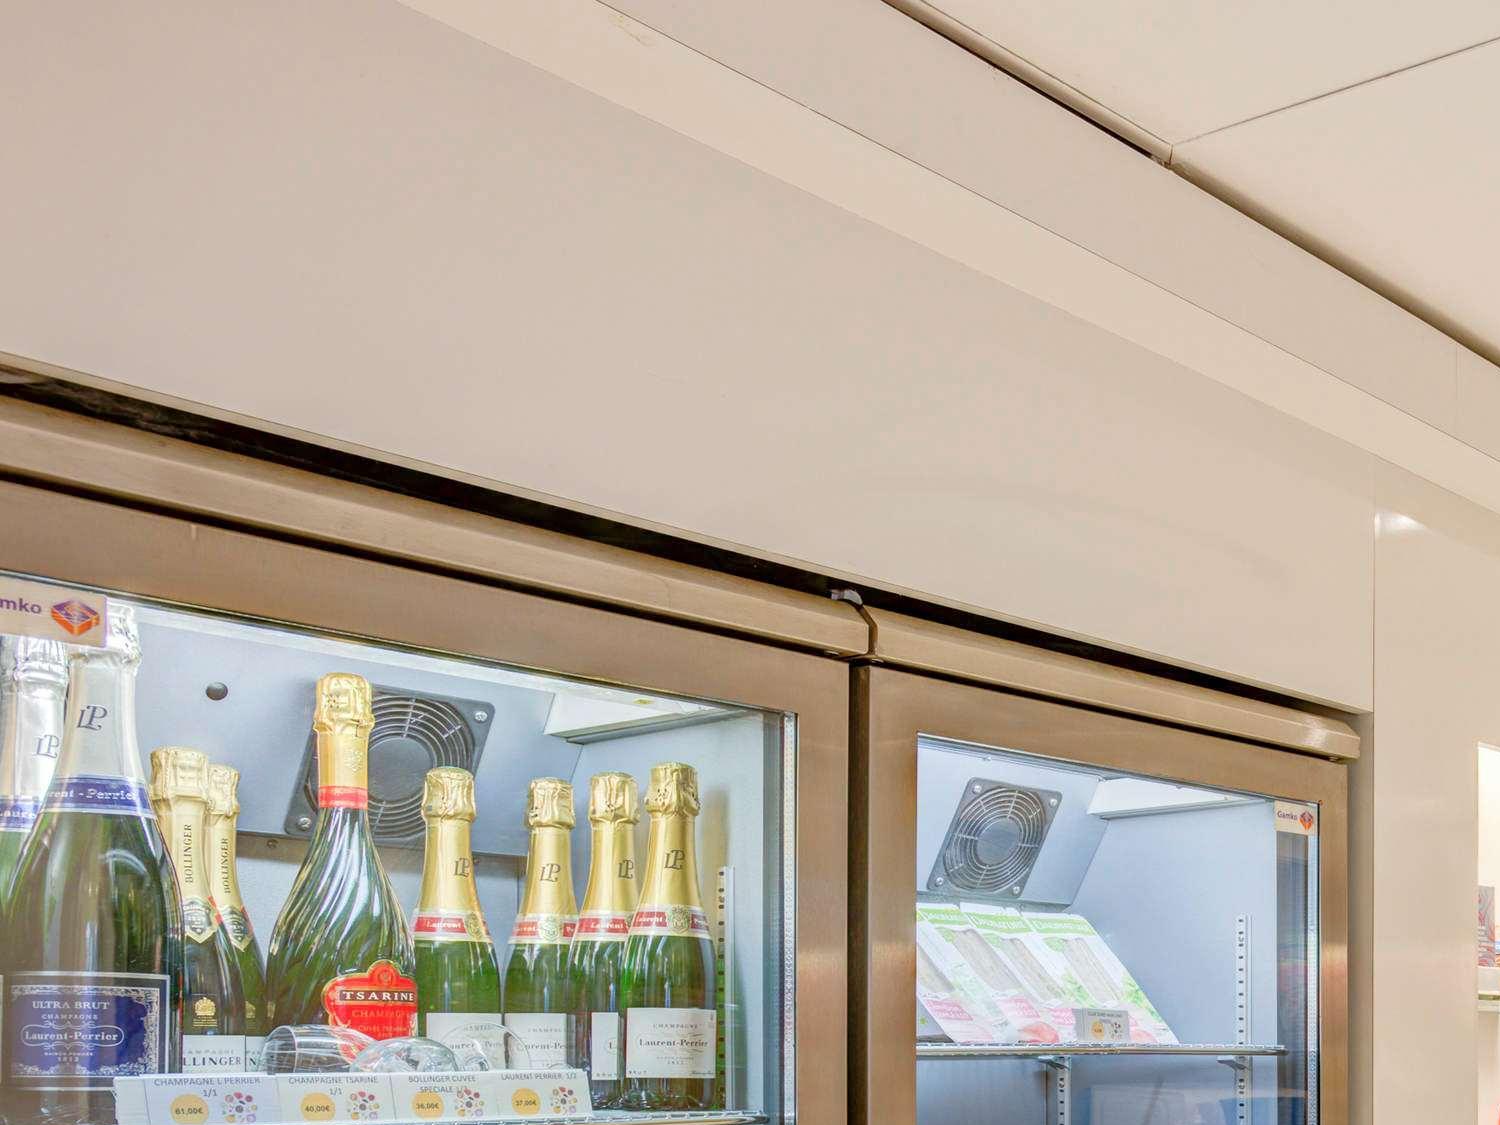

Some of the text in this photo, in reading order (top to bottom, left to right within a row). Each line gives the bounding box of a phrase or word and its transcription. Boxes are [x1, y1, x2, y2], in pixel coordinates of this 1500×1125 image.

[182, 823, 194, 884] BOLLINGER
[218, 837, 230, 895] BOLLINGER
[343, 990, 415, 1002] TSARINE
[32, 1000, 110, 1010] ULTRA BRUT
[24, 1030, 119, 1044] Laurent-Perrier
[639, 1037, 709, 1048] Laurent-Perrier
[154, 1076, 216, 1086] CHAMPAGNE
[223, 1076, 261, 1086] PERRIER
